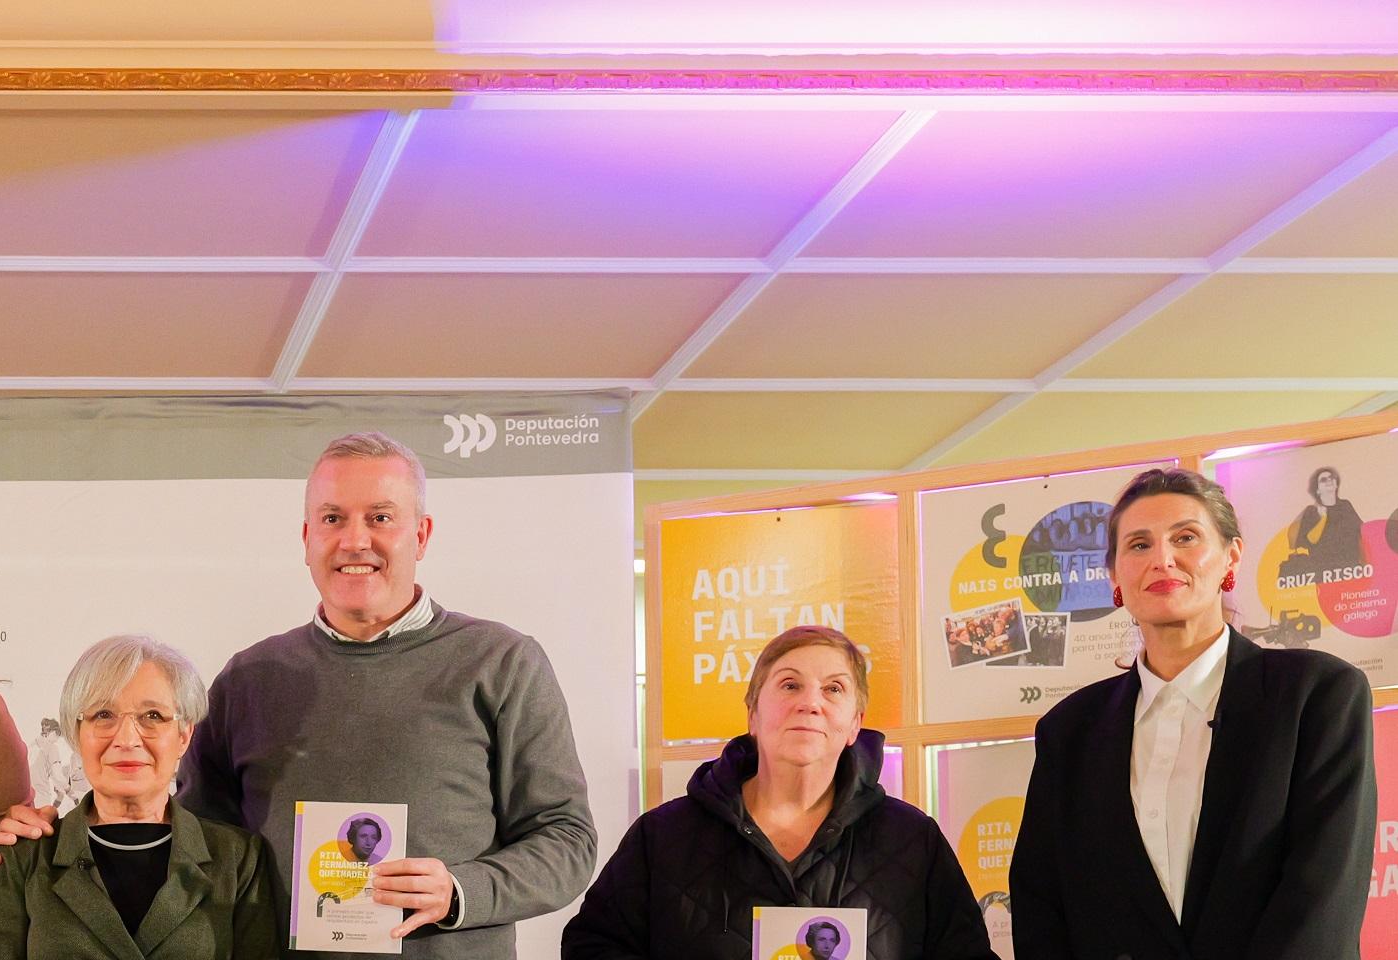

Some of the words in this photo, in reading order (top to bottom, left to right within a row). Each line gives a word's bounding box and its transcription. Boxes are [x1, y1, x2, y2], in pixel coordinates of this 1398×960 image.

[505, 414, 600, 434] Deputación
[505, 431, 600, 447] Pontevedra
[691, 556, 791, 602] AQUÍ
[958, 579, 997, 595] NAIS
[1003, 570, 1062, 591] CONTRA
[1068, 570, 1079, 583] A
[1276, 572, 1316, 590] CRUZ
[1322, 564, 1374, 584] RISCO
[1340, 588, 1380, 600] Pioneira
[1333, 601, 1348, 612] do
[1350, 598, 1387, 610] cinema
[1342, 609, 1379, 622] galego
[977, 821, 1012, 836] RITA
[319, 851, 342, 859] RITA
